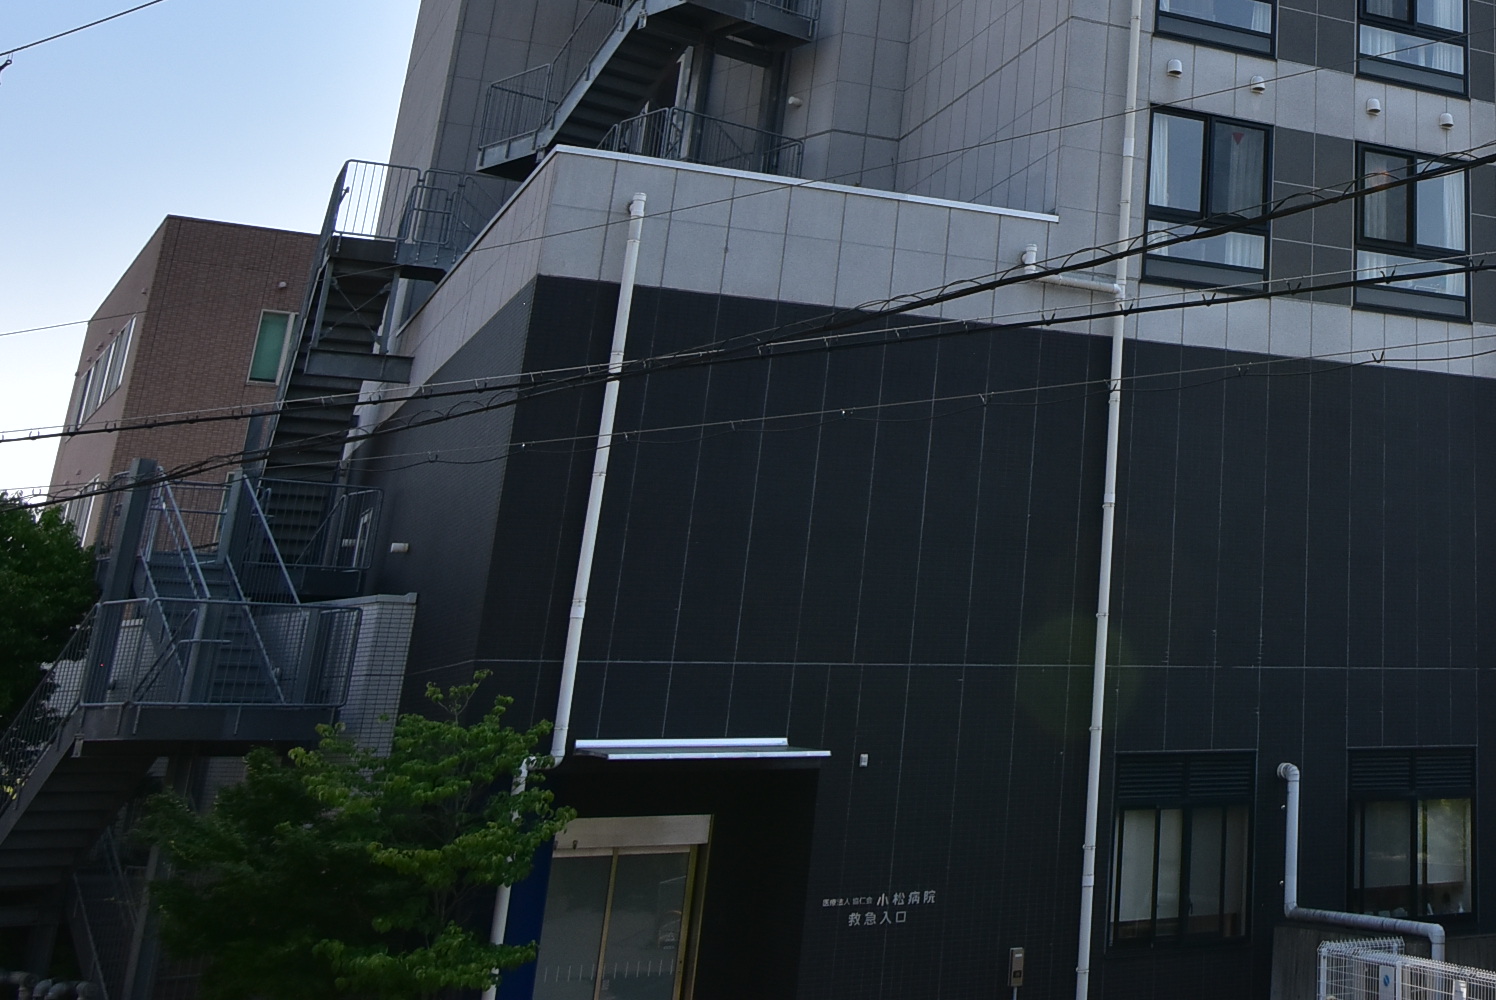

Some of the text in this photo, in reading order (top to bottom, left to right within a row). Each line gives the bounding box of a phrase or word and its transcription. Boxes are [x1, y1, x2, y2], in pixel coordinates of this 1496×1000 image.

[822, 898, 850, 907] 医療法人
[877, 890, 936, 907] 小松病院
[848, 911, 906, 927] 救急入口
